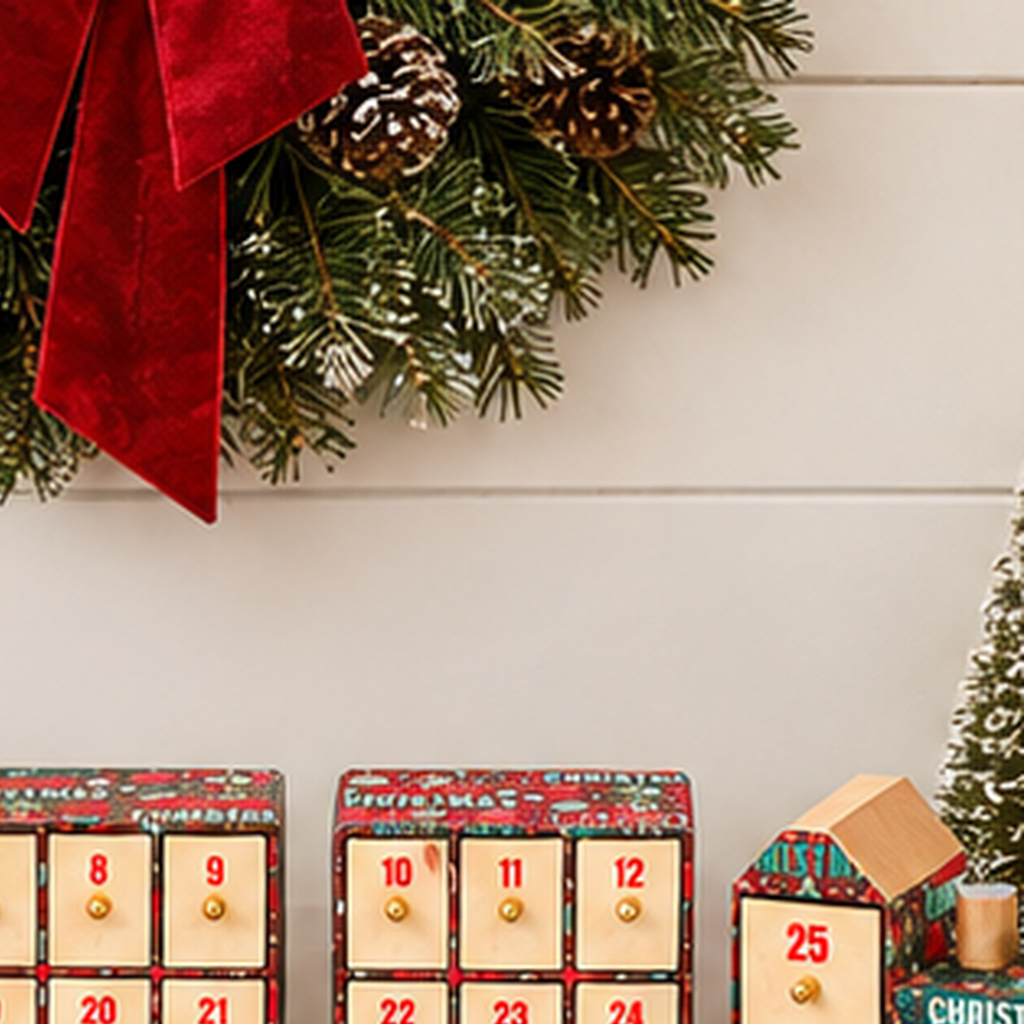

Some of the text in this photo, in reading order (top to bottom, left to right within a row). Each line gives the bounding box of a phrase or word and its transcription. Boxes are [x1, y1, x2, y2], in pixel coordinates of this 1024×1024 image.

[89, 853, 108, 886] 8
[206, 855, 225, 887] 9
[381, 856, 413, 888] 10
[499, 858, 522, 889] 11
[615, 857, 645, 889] 12
[786, 922, 829, 964] 25
